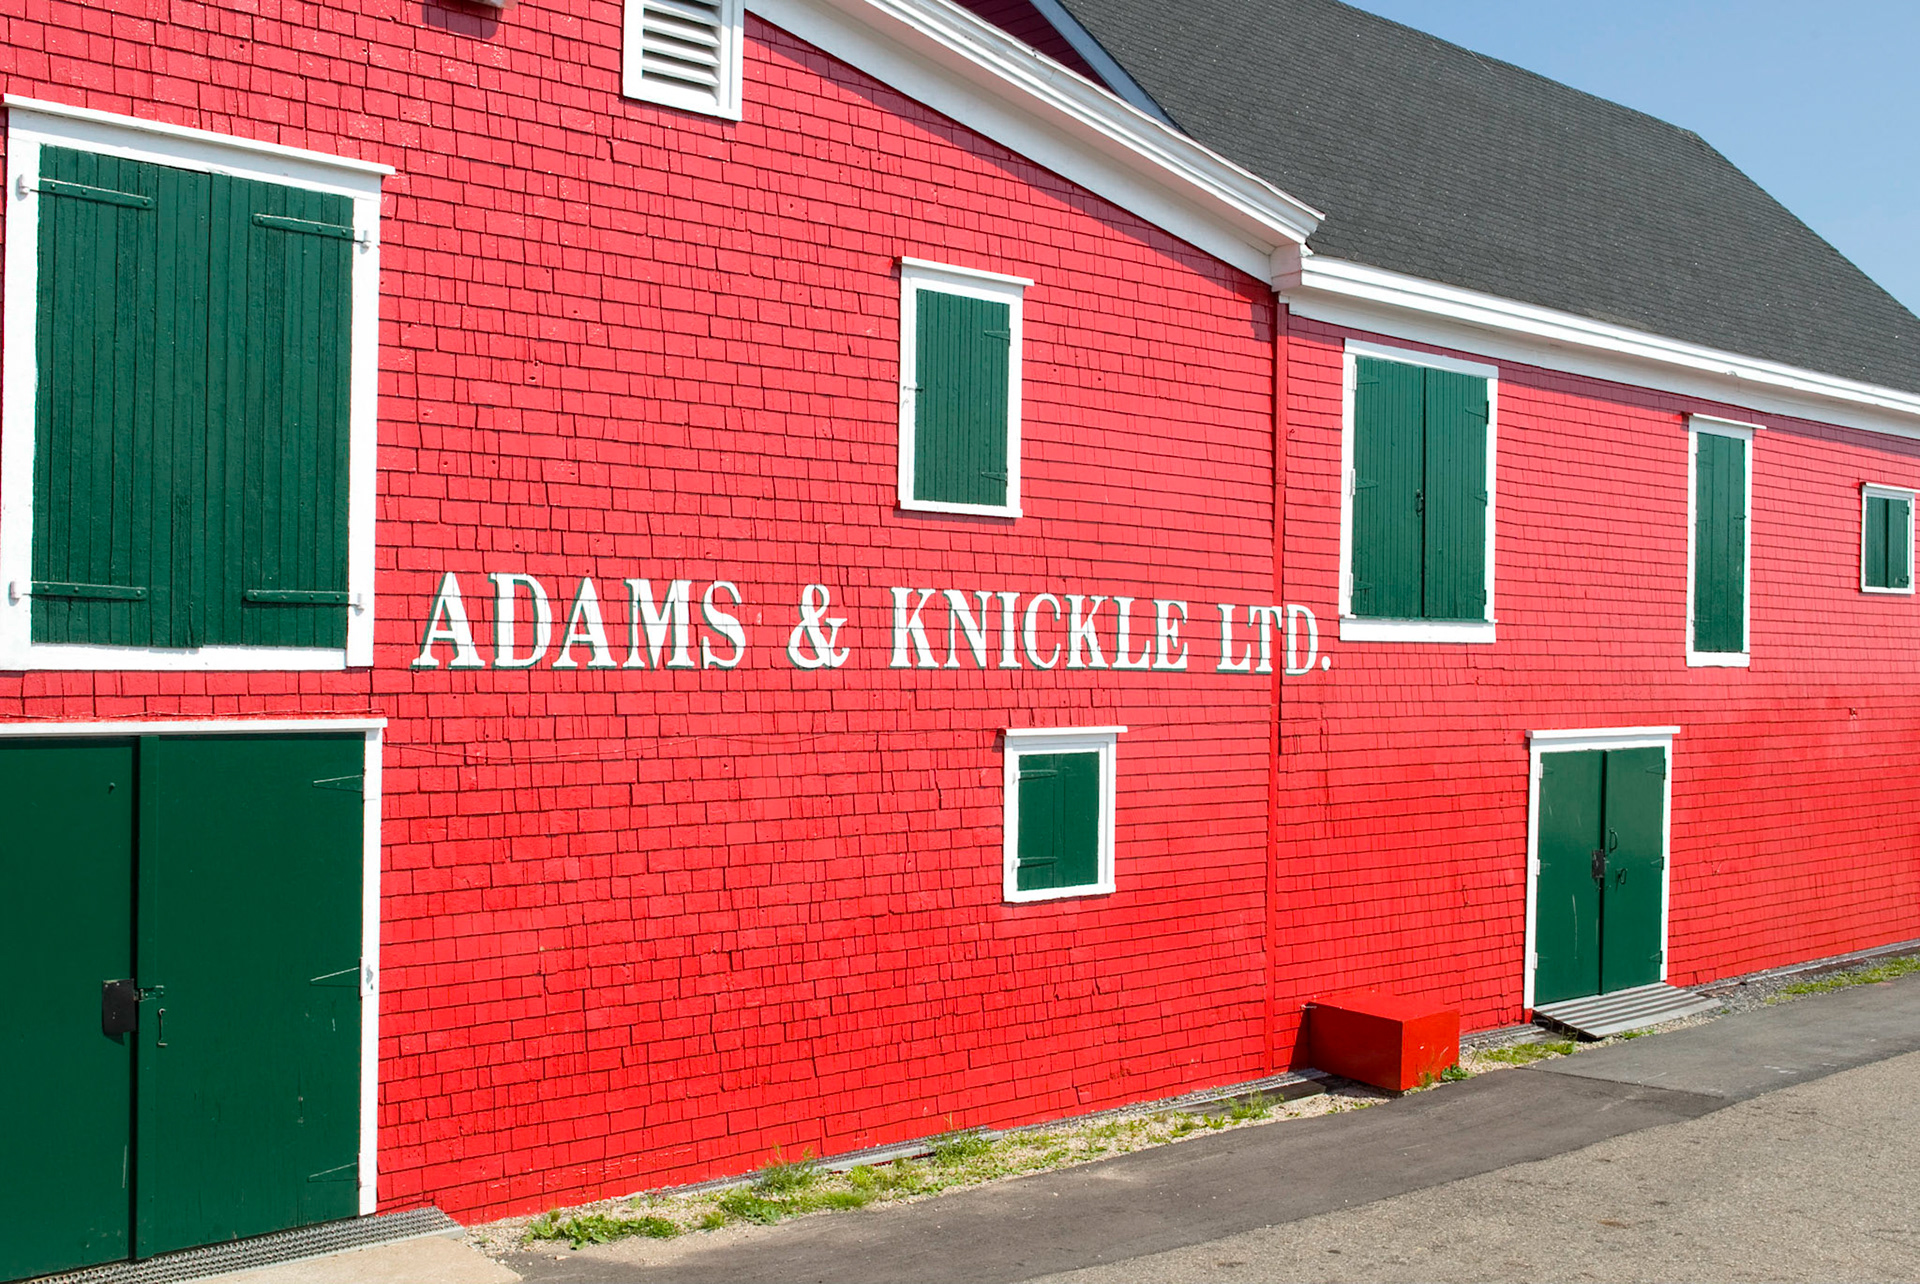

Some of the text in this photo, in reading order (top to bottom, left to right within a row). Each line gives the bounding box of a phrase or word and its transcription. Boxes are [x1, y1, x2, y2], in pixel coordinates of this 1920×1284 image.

[412, 571, 1332, 676] ADAMS & KNICKLE LTD.
